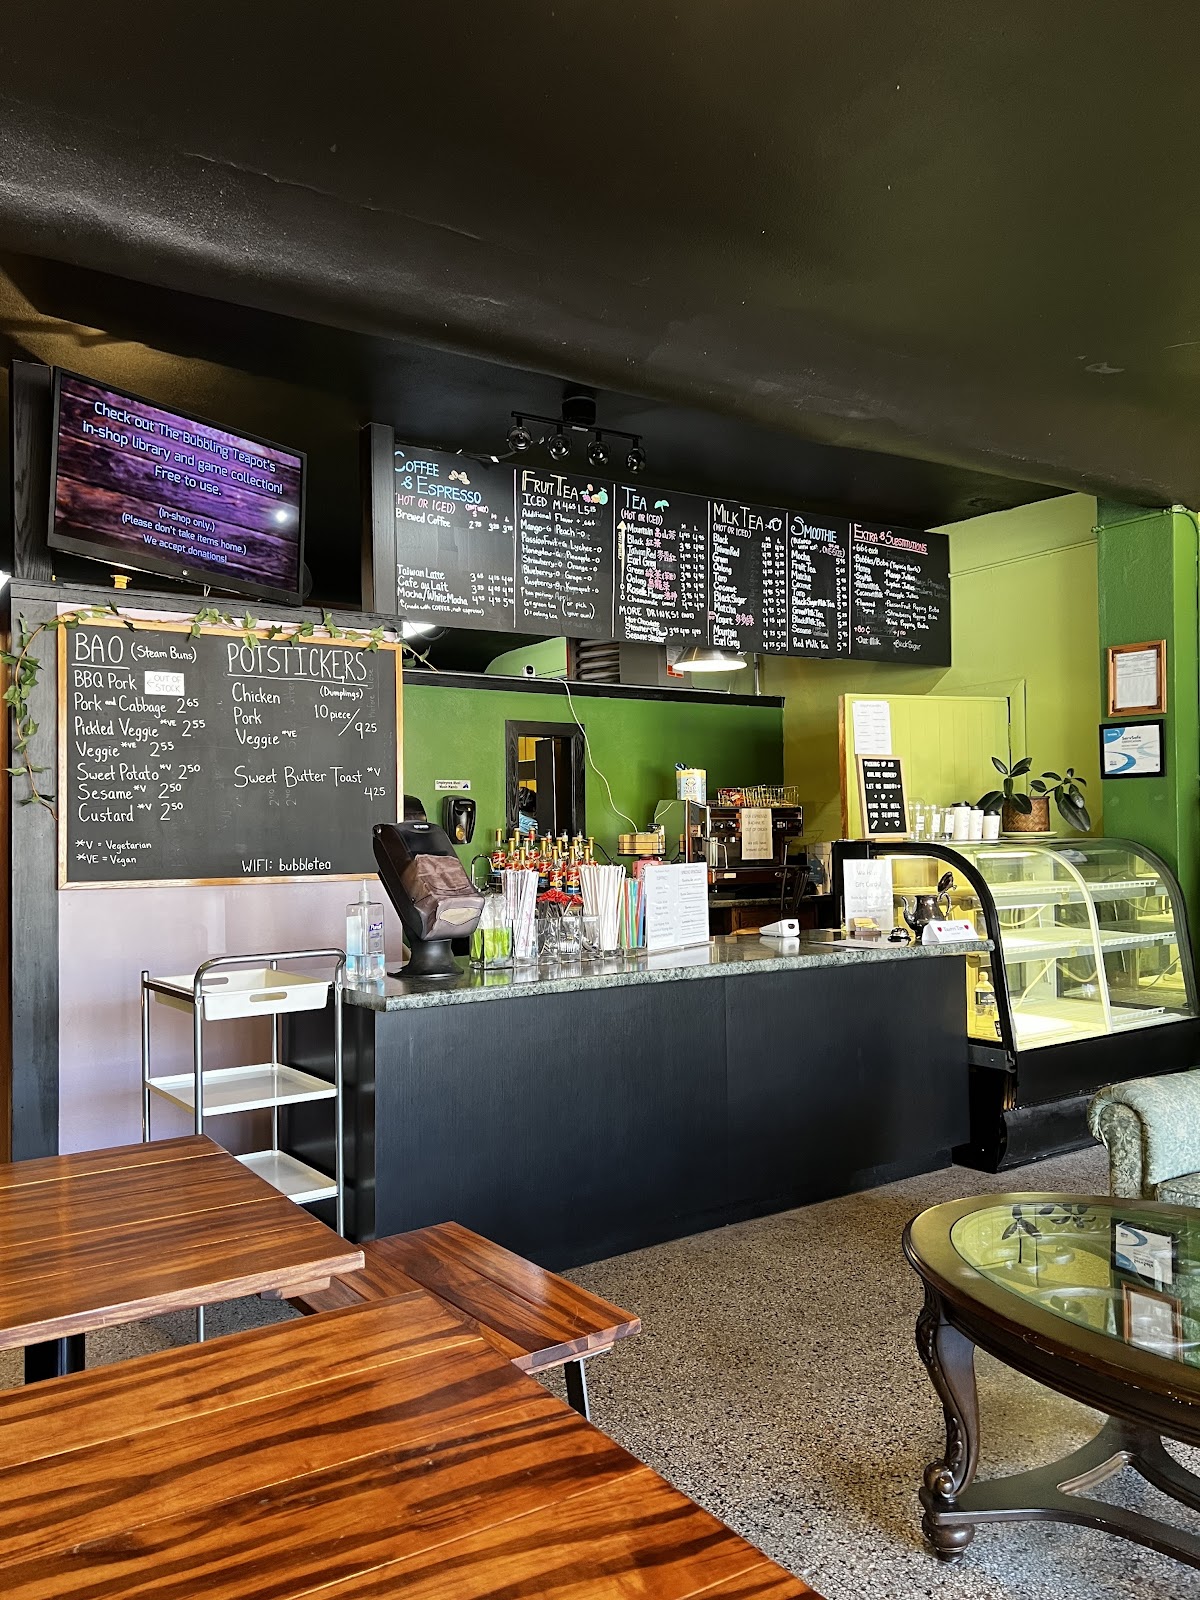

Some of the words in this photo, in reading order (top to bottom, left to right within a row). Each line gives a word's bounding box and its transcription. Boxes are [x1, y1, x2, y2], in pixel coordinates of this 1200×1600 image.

[94, 401, 131, 424] Check
[134, 418, 154, 432] out
[159, 422, 179, 440] The
[182, 431, 229, 459] Bubbling
[232, 447, 276, 472] Teapot's
[83, 420, 128, 447] in-shop
[132, 435, 171, 461] library
[174, 452, 195, 467] and
[197, 460, 228, 476] game
[231, 471, 283, 495] collection!
[154, 465, 181, 484] Free
[184, 475, 197, 487] to
[199, 481, 222, 496] use.
[416, 475, 482, 504] ESPRESSO
[521, 470, 555, 496] FRUIT
[549, 473, 579, 502] TEA
[417, 498, 429, 509] OR
[432, 499, 456, 515] ICED)
[522, 492, 548, 508] ICED
[621, 485, 648, 512] TEA
[158, 506, 191, 526] (In-shop
[192, 518, 215, 532] only.)
[395, 507, 426, 524] Brewed
[426, 513, 452, 528] Coffee
[620, 508, 637, 520] (HOT
[637, 513, 646, 522] OR
[646, 513, 663, 526] ICED)
[713, 502, 740, 527] MILK
[739, 505, 764, 532] TEA
[121, 512, 153, 529] (Please
[154, 522, 177, 535] don't
[178, 529, 196, 541] take
[197, 533, 219, 547] items
[220, 539, 247, 556] home.)
[727, 525, 735, 535] OR
[735, 527, 752, 539] ICED)
[790, 515, 838, 544] SMOOTHIE
[853, 523, 878, 542] EXTRA
[142, 534, 157, 546] We
[158, 539, 186, 554] accept
[187, 545, 228, 563] donations!
[396, 563, 425, 578] Taiwan
[425, 567, 446, 580] Latte
[397, 575, 419, 589] Cafe
[430, 580, 449, 593] Lait
[619, 605, 642, 616] MORE
[645, 607, 680, 620] DRINKS!
[713, 601, 737, 615] Matcha
[75, 632, 124, 664] BAO
[130, 641, 168, 662] (Steam
[169, 645, 198, 664] Buns)
[792, 636, 804, 648] Red
[227, 642, 367, 681] POTSTICKERS
[74, 669, 104, 689] BBQ
[107, 672, 138, 691] Pork
[153, 674, 170, 683] OUT
[170, 675, 182, 683] OF
[155, 684, 181, 693] STOCK
[231, 682, 281, 705] Chicken
[319, 685, 364, 701] (Dumplings)
[74, 692, 103, 712] Pork
[104, 696, 117, 706] and
[118, 695, 167, 719] Cabbage
[233, 706, 263, 725] Pork
[74, 715, 114, 737] Pickled
[118, 717, 160, 742] Veggie
[235, 727, 280, 750] Veggie
[75, 741, 120, 763] Veggie
[76, 762, 115, 781] Sweet
[119, 762, 160, 782] Potato
[233, 765, 277, 788] Sweet
[284, 766, 327, 788] Butter
[329, 766, 363, 787] Toast
[77, 783, 133, 801] Sesame
[78, 802, 135, 822] Custard
[105, 840, 152, 854] Vegetarian
[109, 854, 137, 868] Vegan
[241, 858, 273, 873] WIFI:
[279, 856, 332, 872] bubbletea
